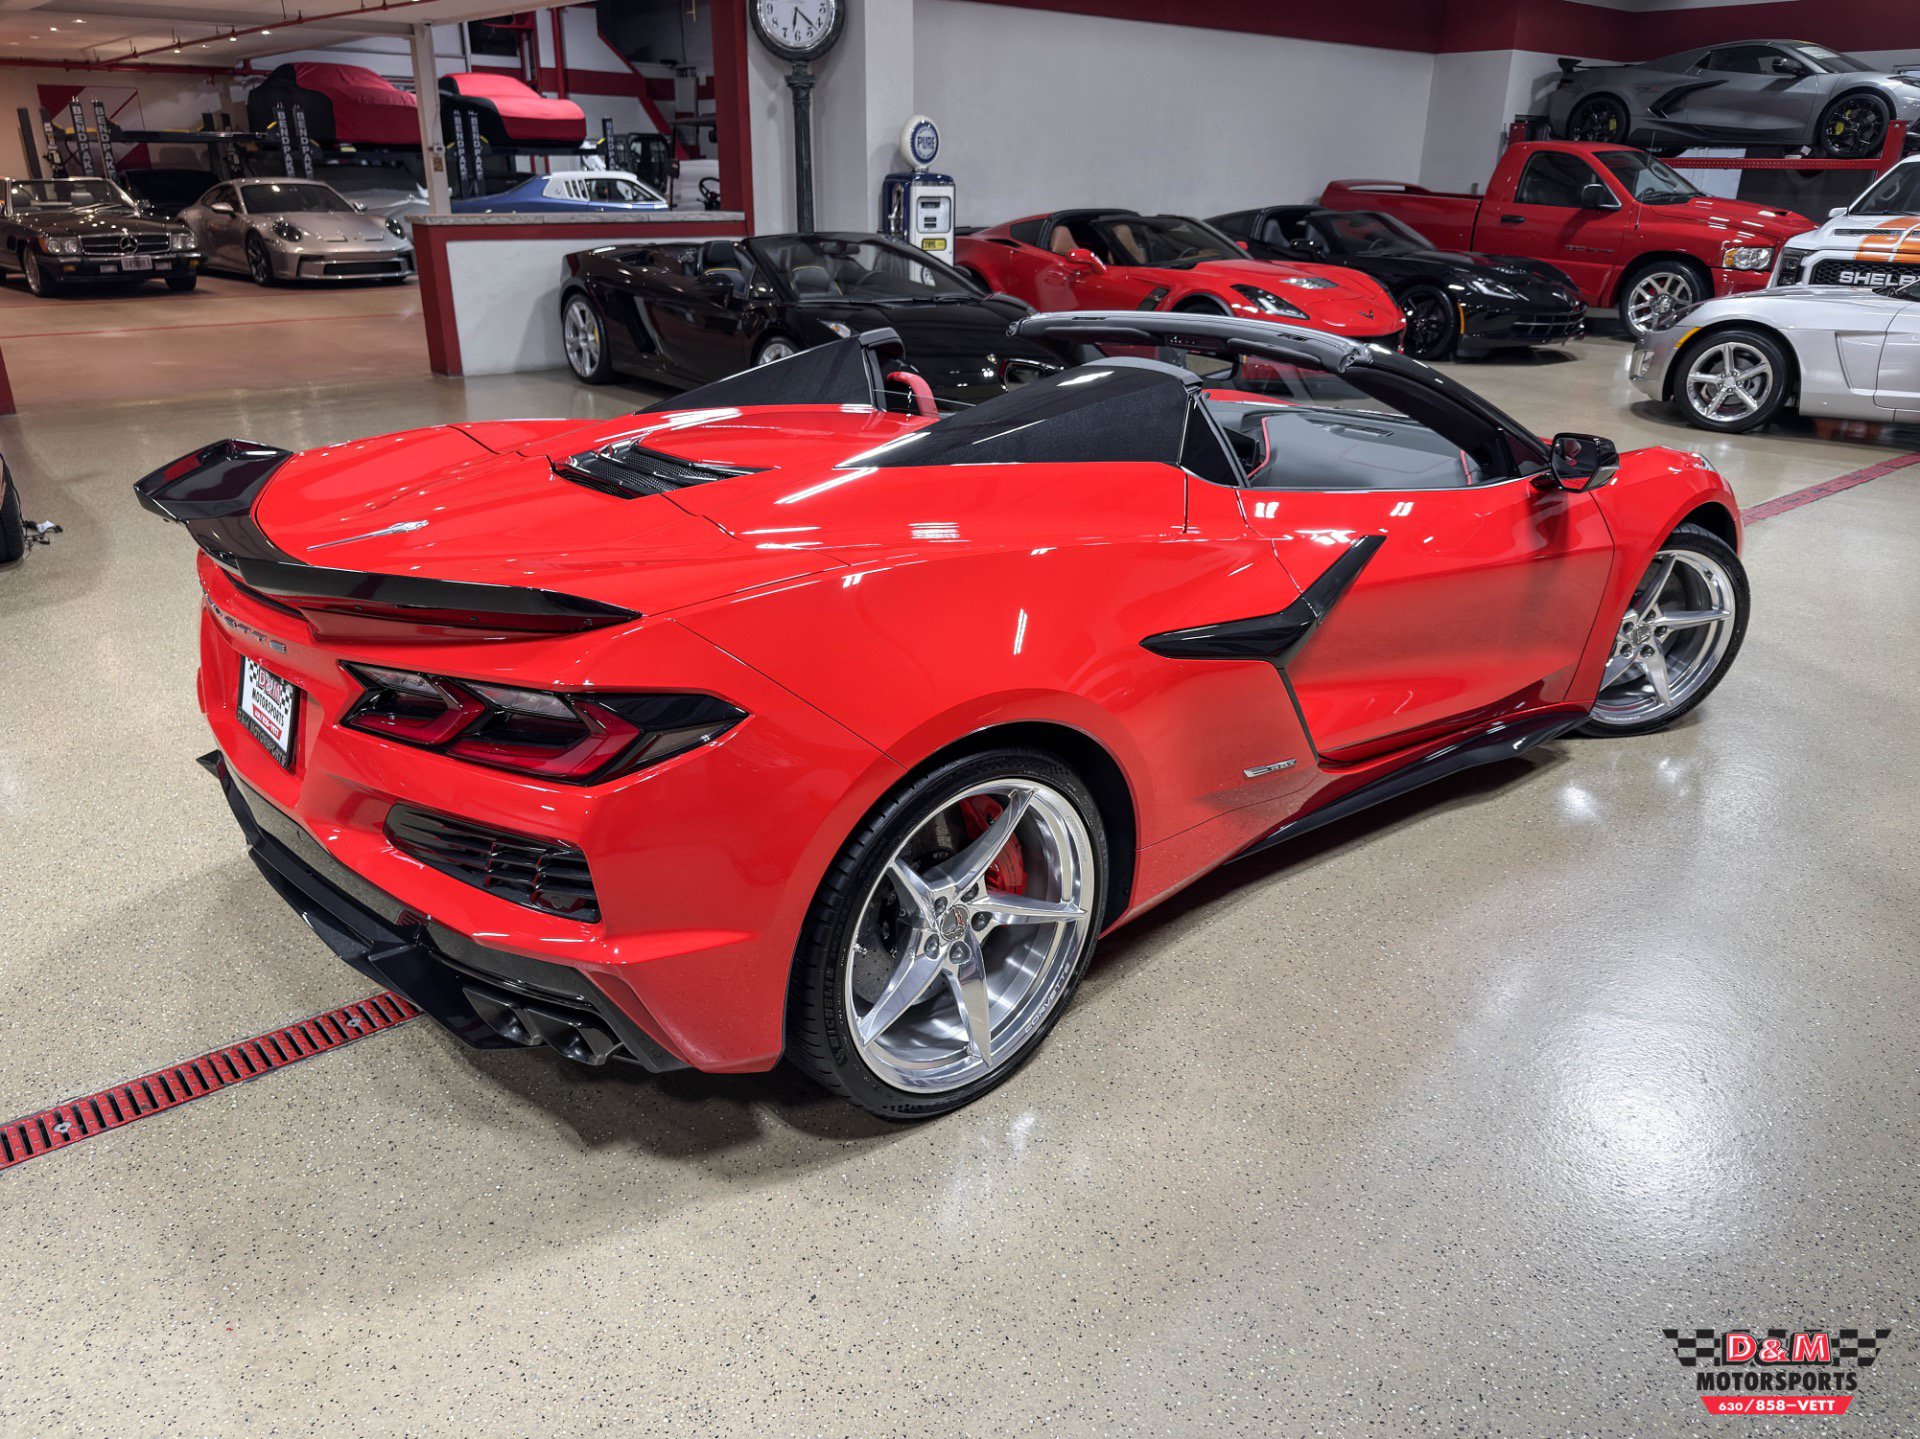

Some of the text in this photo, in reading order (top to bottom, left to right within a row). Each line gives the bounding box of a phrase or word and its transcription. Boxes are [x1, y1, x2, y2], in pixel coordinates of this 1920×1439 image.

[917, 136, 935, 149] PURE
[252, 686, 285, 728] MOTORSPORTS
[1024, 962, 1070, 1035] CORVETTE
